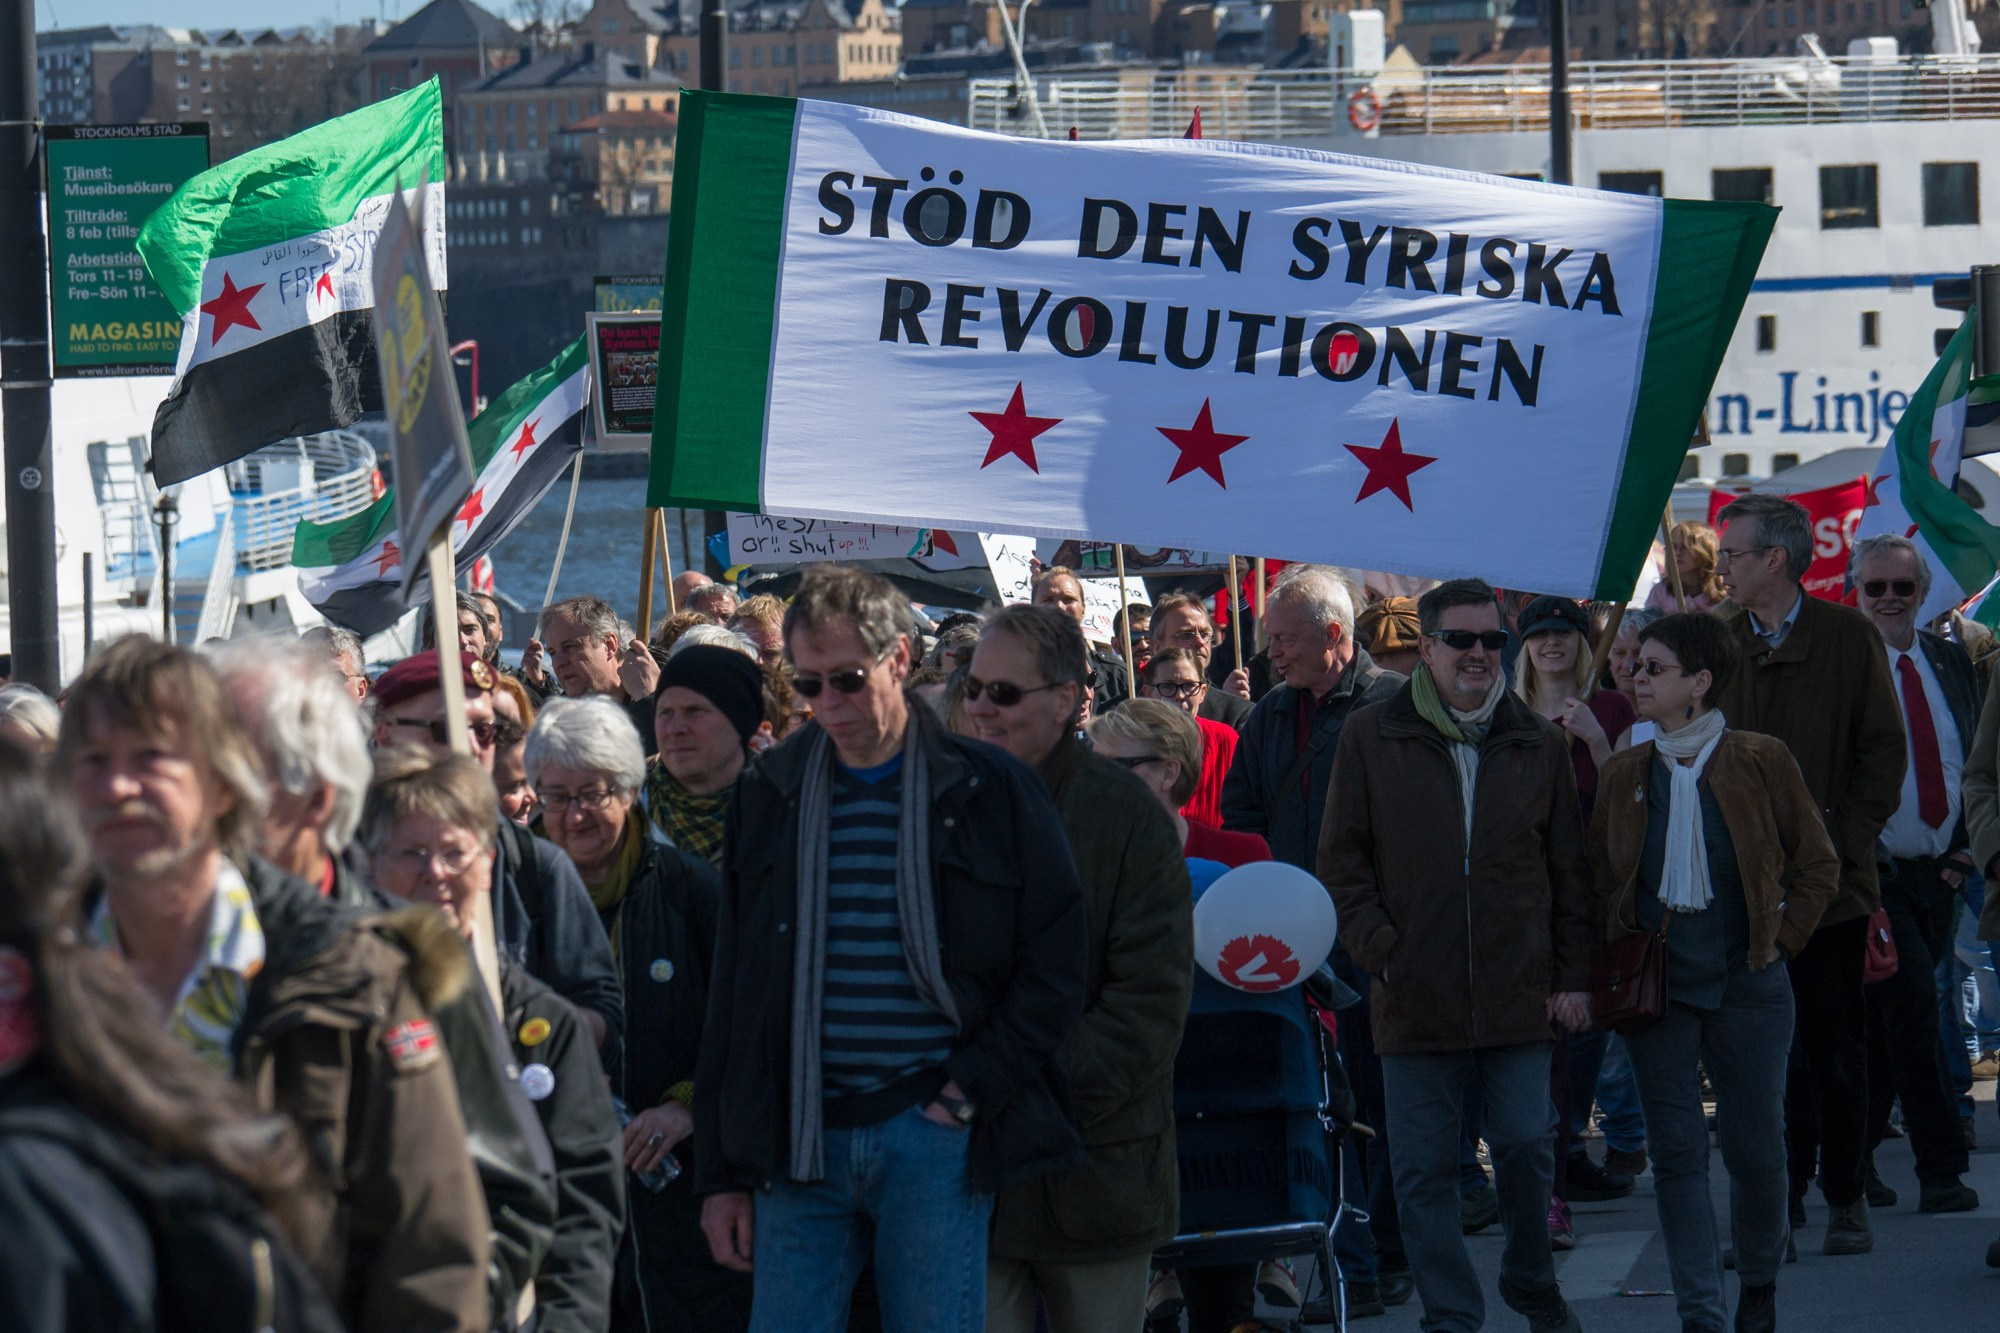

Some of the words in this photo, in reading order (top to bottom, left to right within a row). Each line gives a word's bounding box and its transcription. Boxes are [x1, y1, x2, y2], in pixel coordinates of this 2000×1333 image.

[74, 126, 150, 139] STOCKHOLMS
[153, 125, 182, 136] STAD
[63, 166, 113, 181] Tjänst:
[64, 181, 173, 196] Museibesökare
[65, 209, 128, 224] Tillträde:
[66, 227, 75, 239] 8
[79, 226, 102, 239] feb
[818, 166, 1031, 250] STÖD
[1077, 197, 1251, 274] DEN
[1288, 217, 1623, 317] SYRISKA
[68, 270, 97, 283] Tors
[69, 321, 181, 341] MAGASIN
[70, 344, 95, 353] HARD
[96, 343, 109, 352] TO
[136, 342, 159, 351] EASY
[161, 341, 174, 350] TO
[879, 277, 1545, 408] REVOLUTIONEN
[1708, 370, 1914, 443] n-Linje
[789, 533, 835, 556] shut
[839, 540, 854, 555] up
